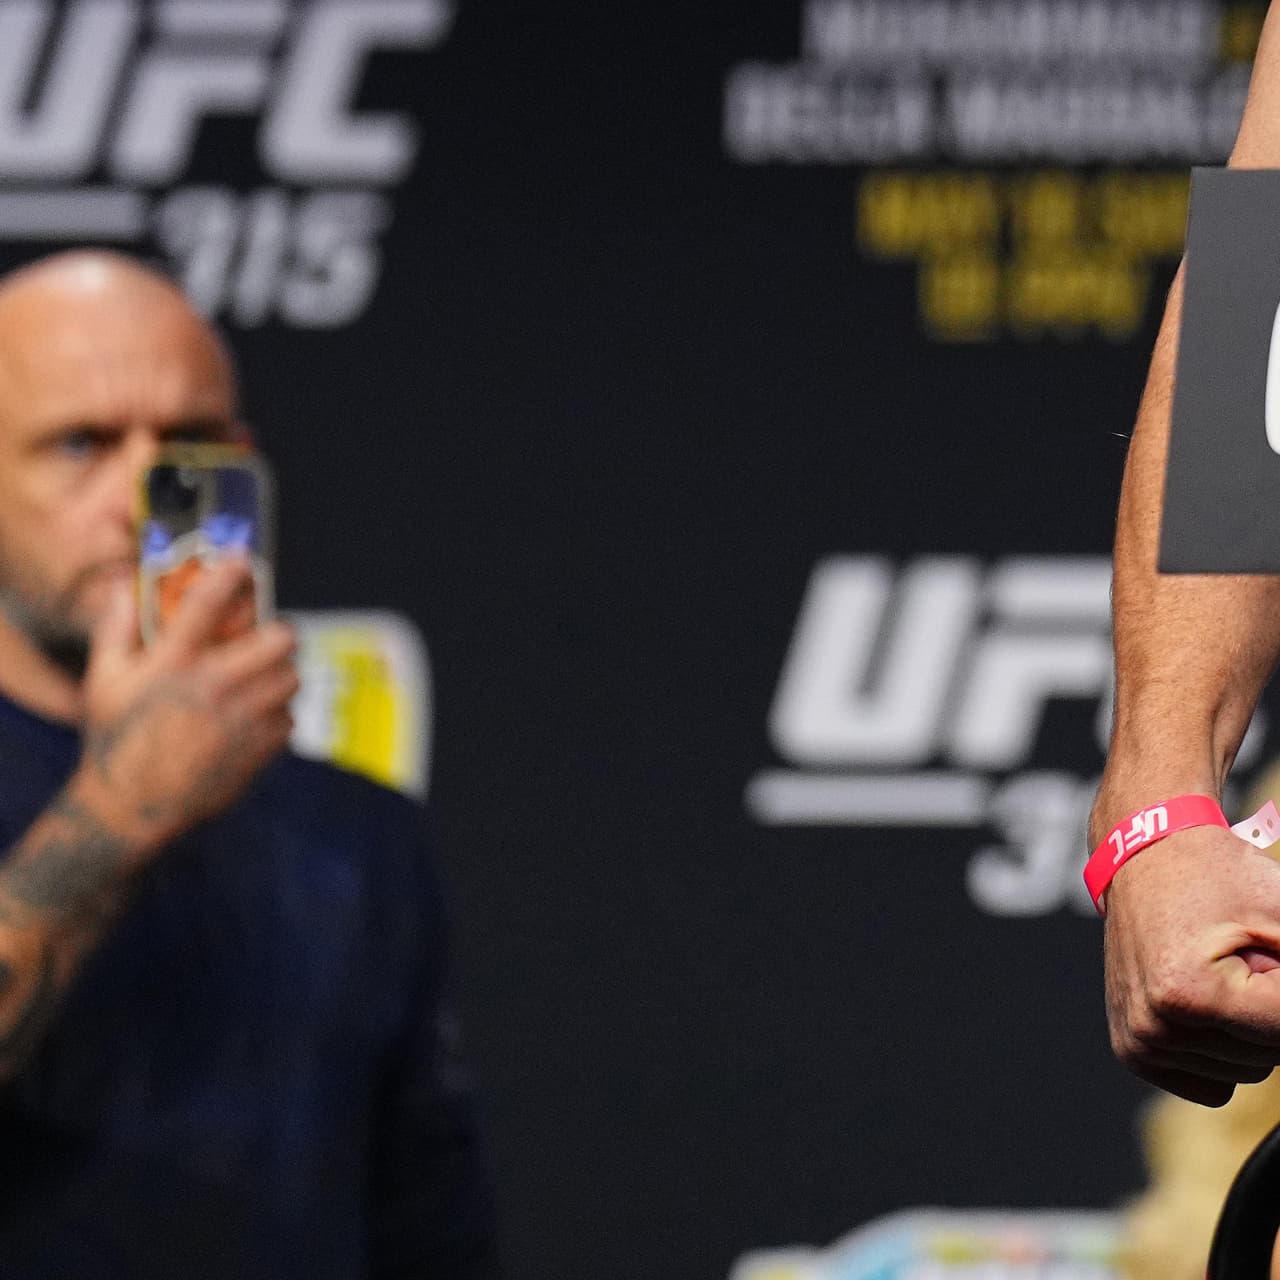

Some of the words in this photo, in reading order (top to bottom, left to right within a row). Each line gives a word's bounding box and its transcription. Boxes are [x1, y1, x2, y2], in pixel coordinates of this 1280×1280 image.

[157, 184, 396, 330] 315
[766, 552, 1116, 771] UF
[1108, 806, 1168, 865] UFC
